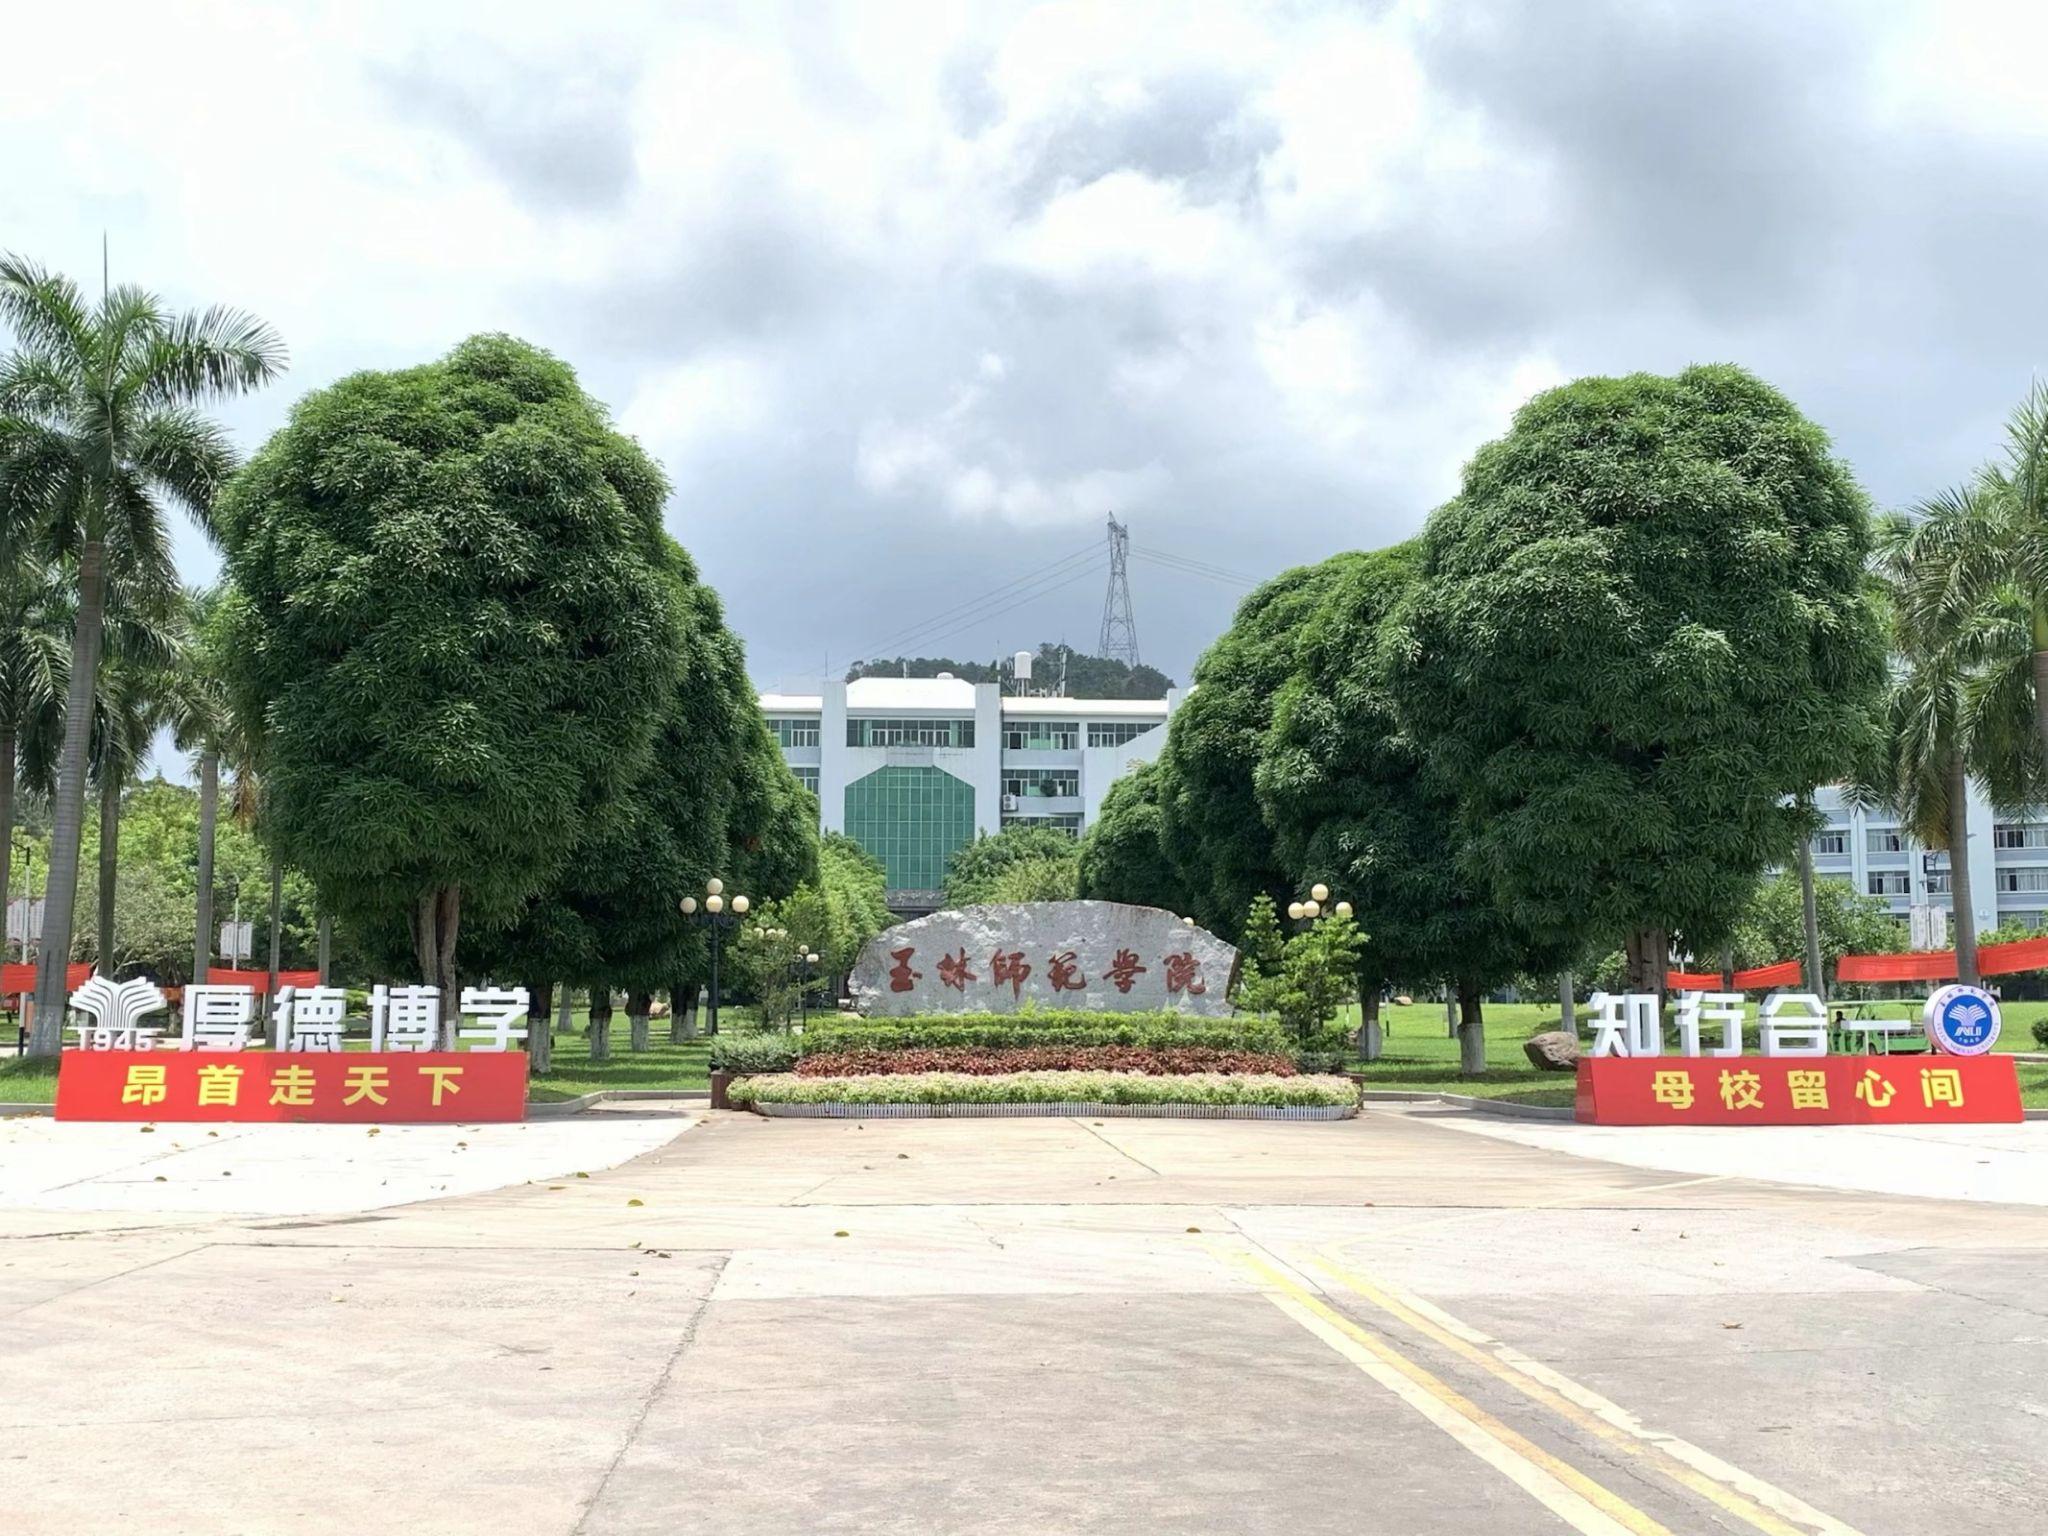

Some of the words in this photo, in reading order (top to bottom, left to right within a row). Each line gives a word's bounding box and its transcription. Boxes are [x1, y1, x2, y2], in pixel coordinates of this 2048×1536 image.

[78, 1028, 154, 1051] 1945
[179, 984, 531, 1053] 厚德博学
[1588, 991, 1912, 1057] 知行合一
[121, 1065, 465, 1106] 昂首走天下
[1652, 1068, 1965, 1110] 母校留心间
